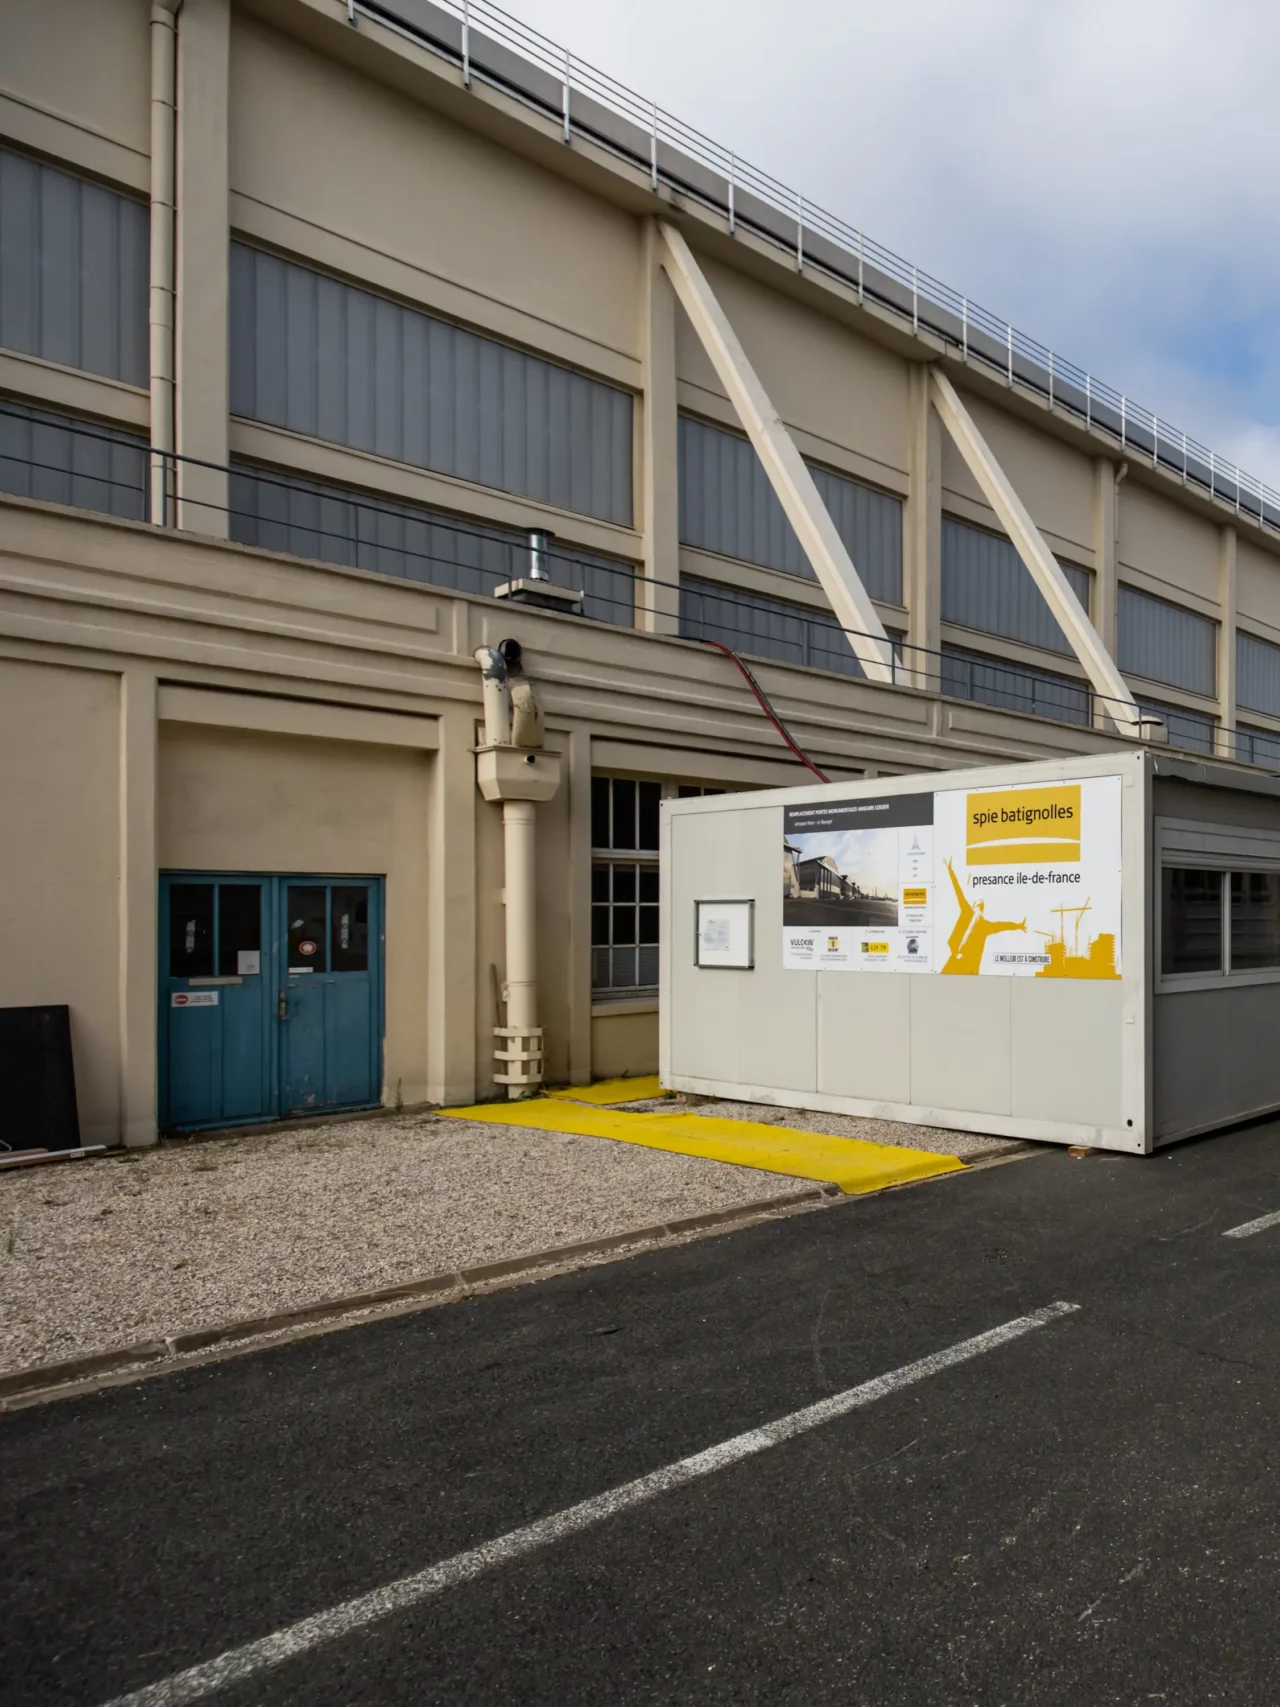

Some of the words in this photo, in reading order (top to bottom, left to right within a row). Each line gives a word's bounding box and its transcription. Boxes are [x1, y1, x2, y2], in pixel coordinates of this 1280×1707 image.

[973, 808, 998, 828] spie
[1001, 803, 1074, 825] batignolles
[972, 875, 1014, 888] presance
[1016, 871, 1081, 885] ile-de-france
